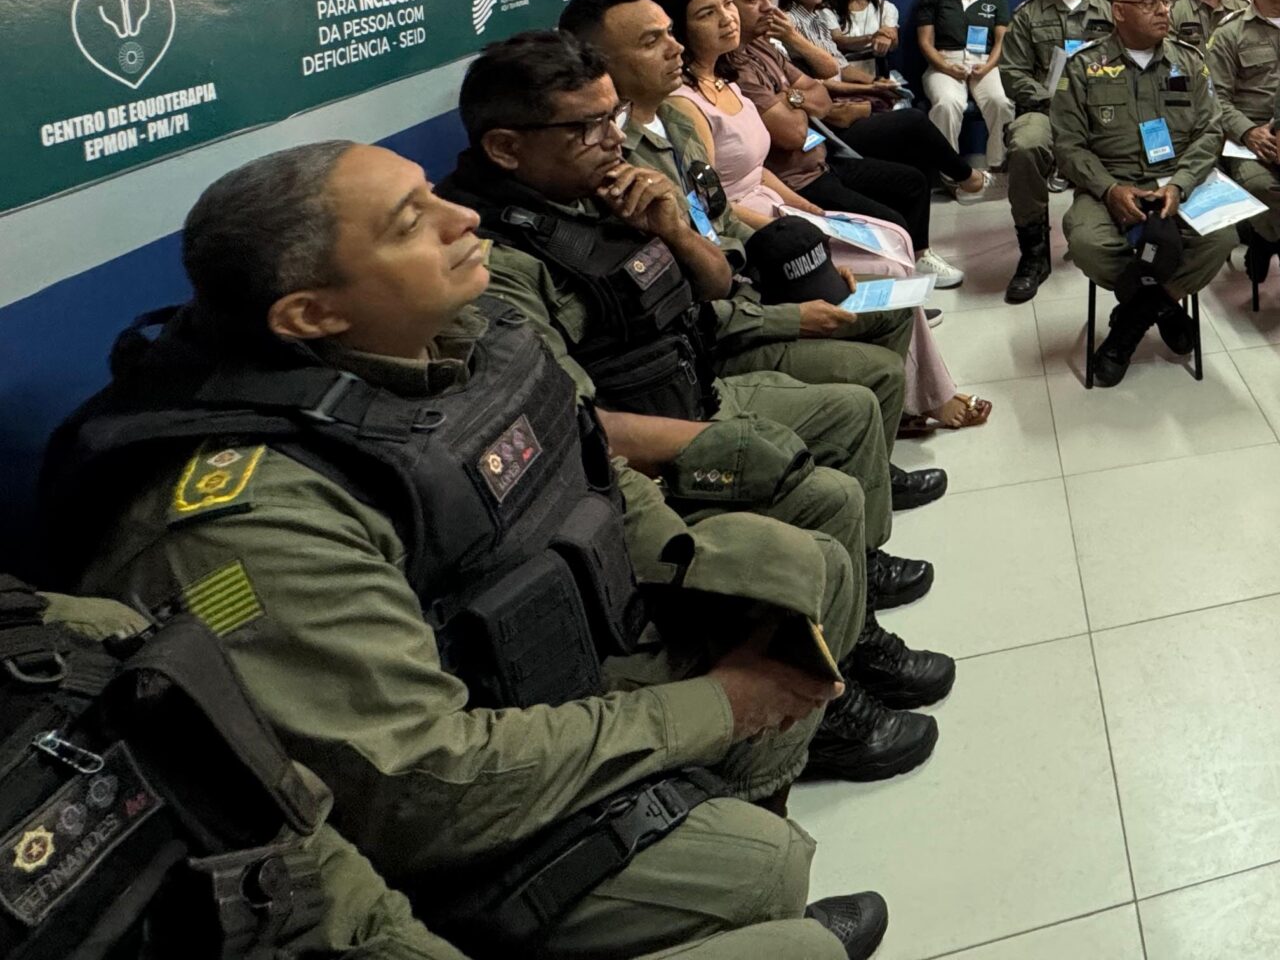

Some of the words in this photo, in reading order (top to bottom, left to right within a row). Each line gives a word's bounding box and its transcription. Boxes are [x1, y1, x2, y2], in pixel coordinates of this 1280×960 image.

[319, 24, 341, 45] DA
[343, 12, 396, 39] PESSOA
[397, 5, 424, 25] COM
[302, 36, 391, 76] DEFICIÊNCIA
[399, 27, 426, 48] SEID
[41, 111, 105, 146] CENTRO
[107, 105, 128, 129] DE
[128, 82, 217, 124] EQUOTERAPIA
[84, 128, 138, 162] EPMON
[147, 113, 190, 142] PM/PI
